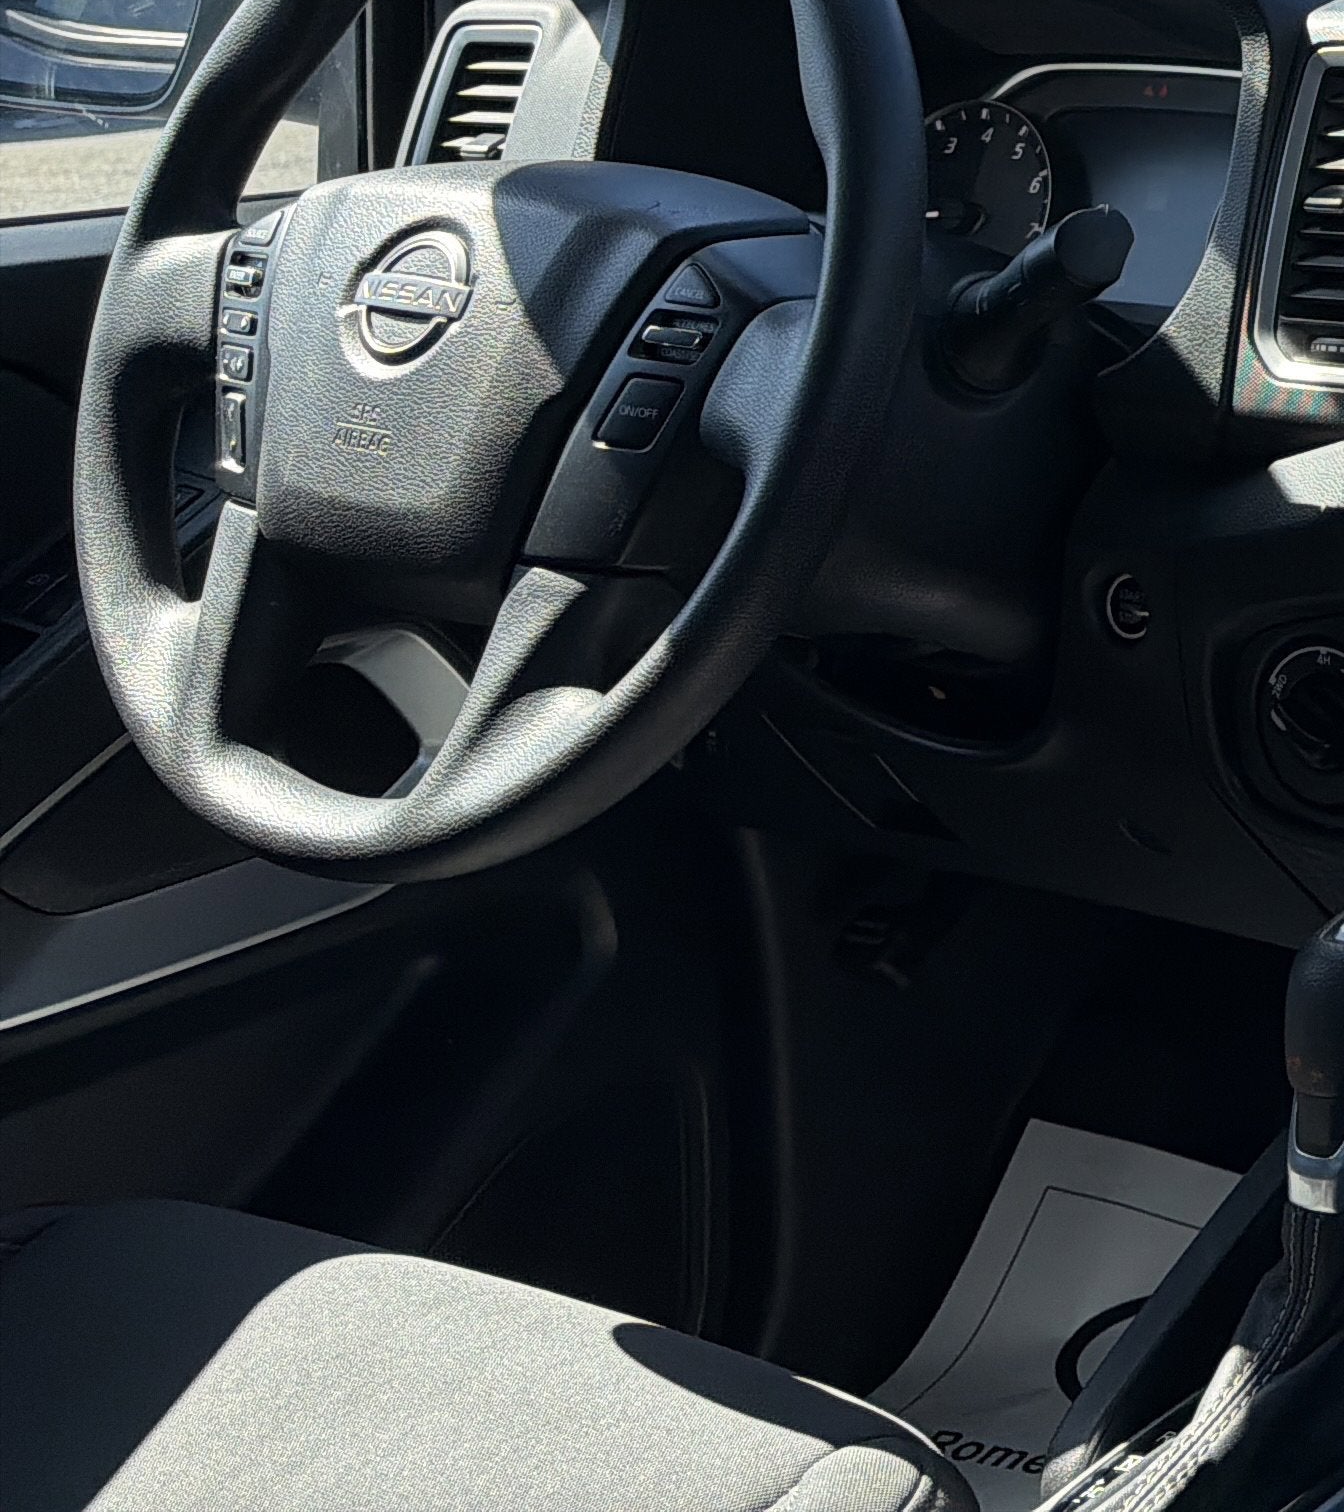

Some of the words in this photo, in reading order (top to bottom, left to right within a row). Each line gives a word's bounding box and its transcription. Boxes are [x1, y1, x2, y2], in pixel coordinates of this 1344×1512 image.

[980, 127, 994, 144] 4
[943, 137, 958, 154] 3
[1010, 142, 1026, 160] 5
[1027, 176, 1043, 194] 6
[1025, 222, 1042, 239] 7
[361, 280, 462, 314] NISSAN
[618, 404, 660, 421] ON/OFF
[1271, 674, 1288, 699] 2WD
[929, 1430, 1048, 1475] Rome
